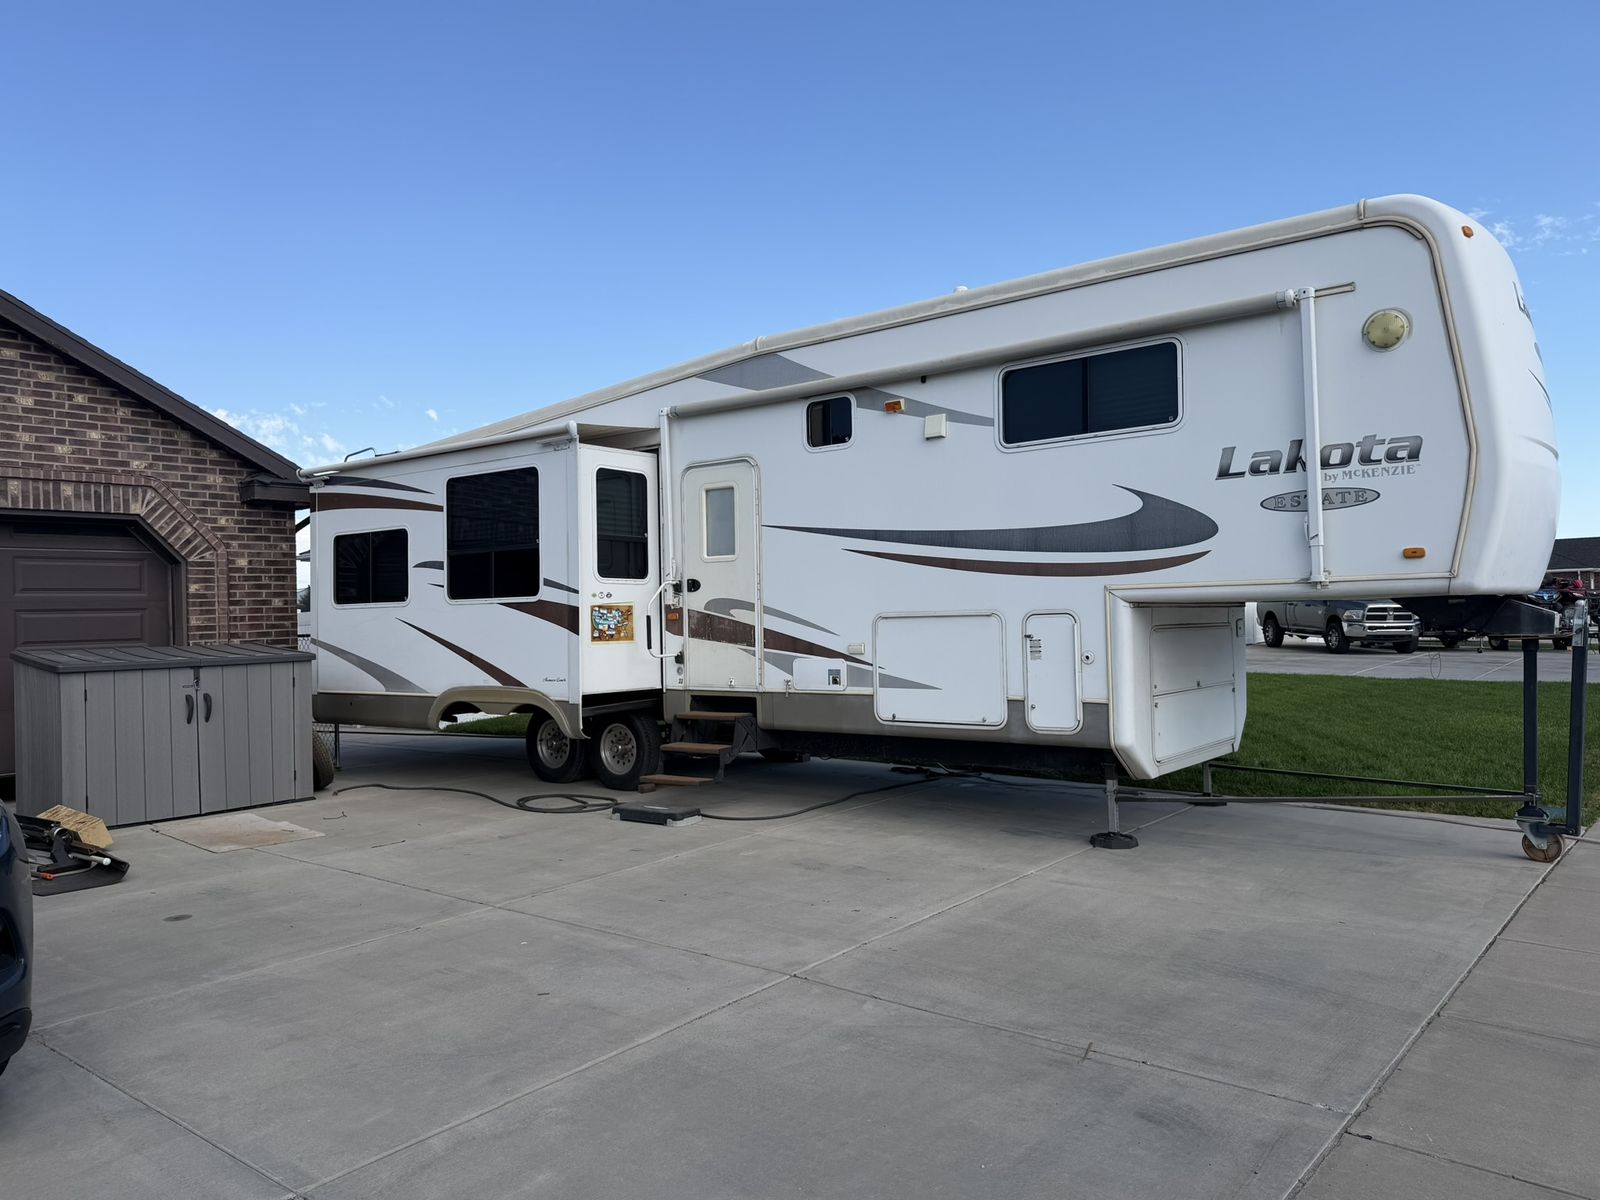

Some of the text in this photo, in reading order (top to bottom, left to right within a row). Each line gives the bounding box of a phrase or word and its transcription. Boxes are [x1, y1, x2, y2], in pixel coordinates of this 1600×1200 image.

[1215, 434, 1423, 480] Lakota
[1324, 472, 1338, 483] by
[1274, 490, 1368, 508] ESATE
